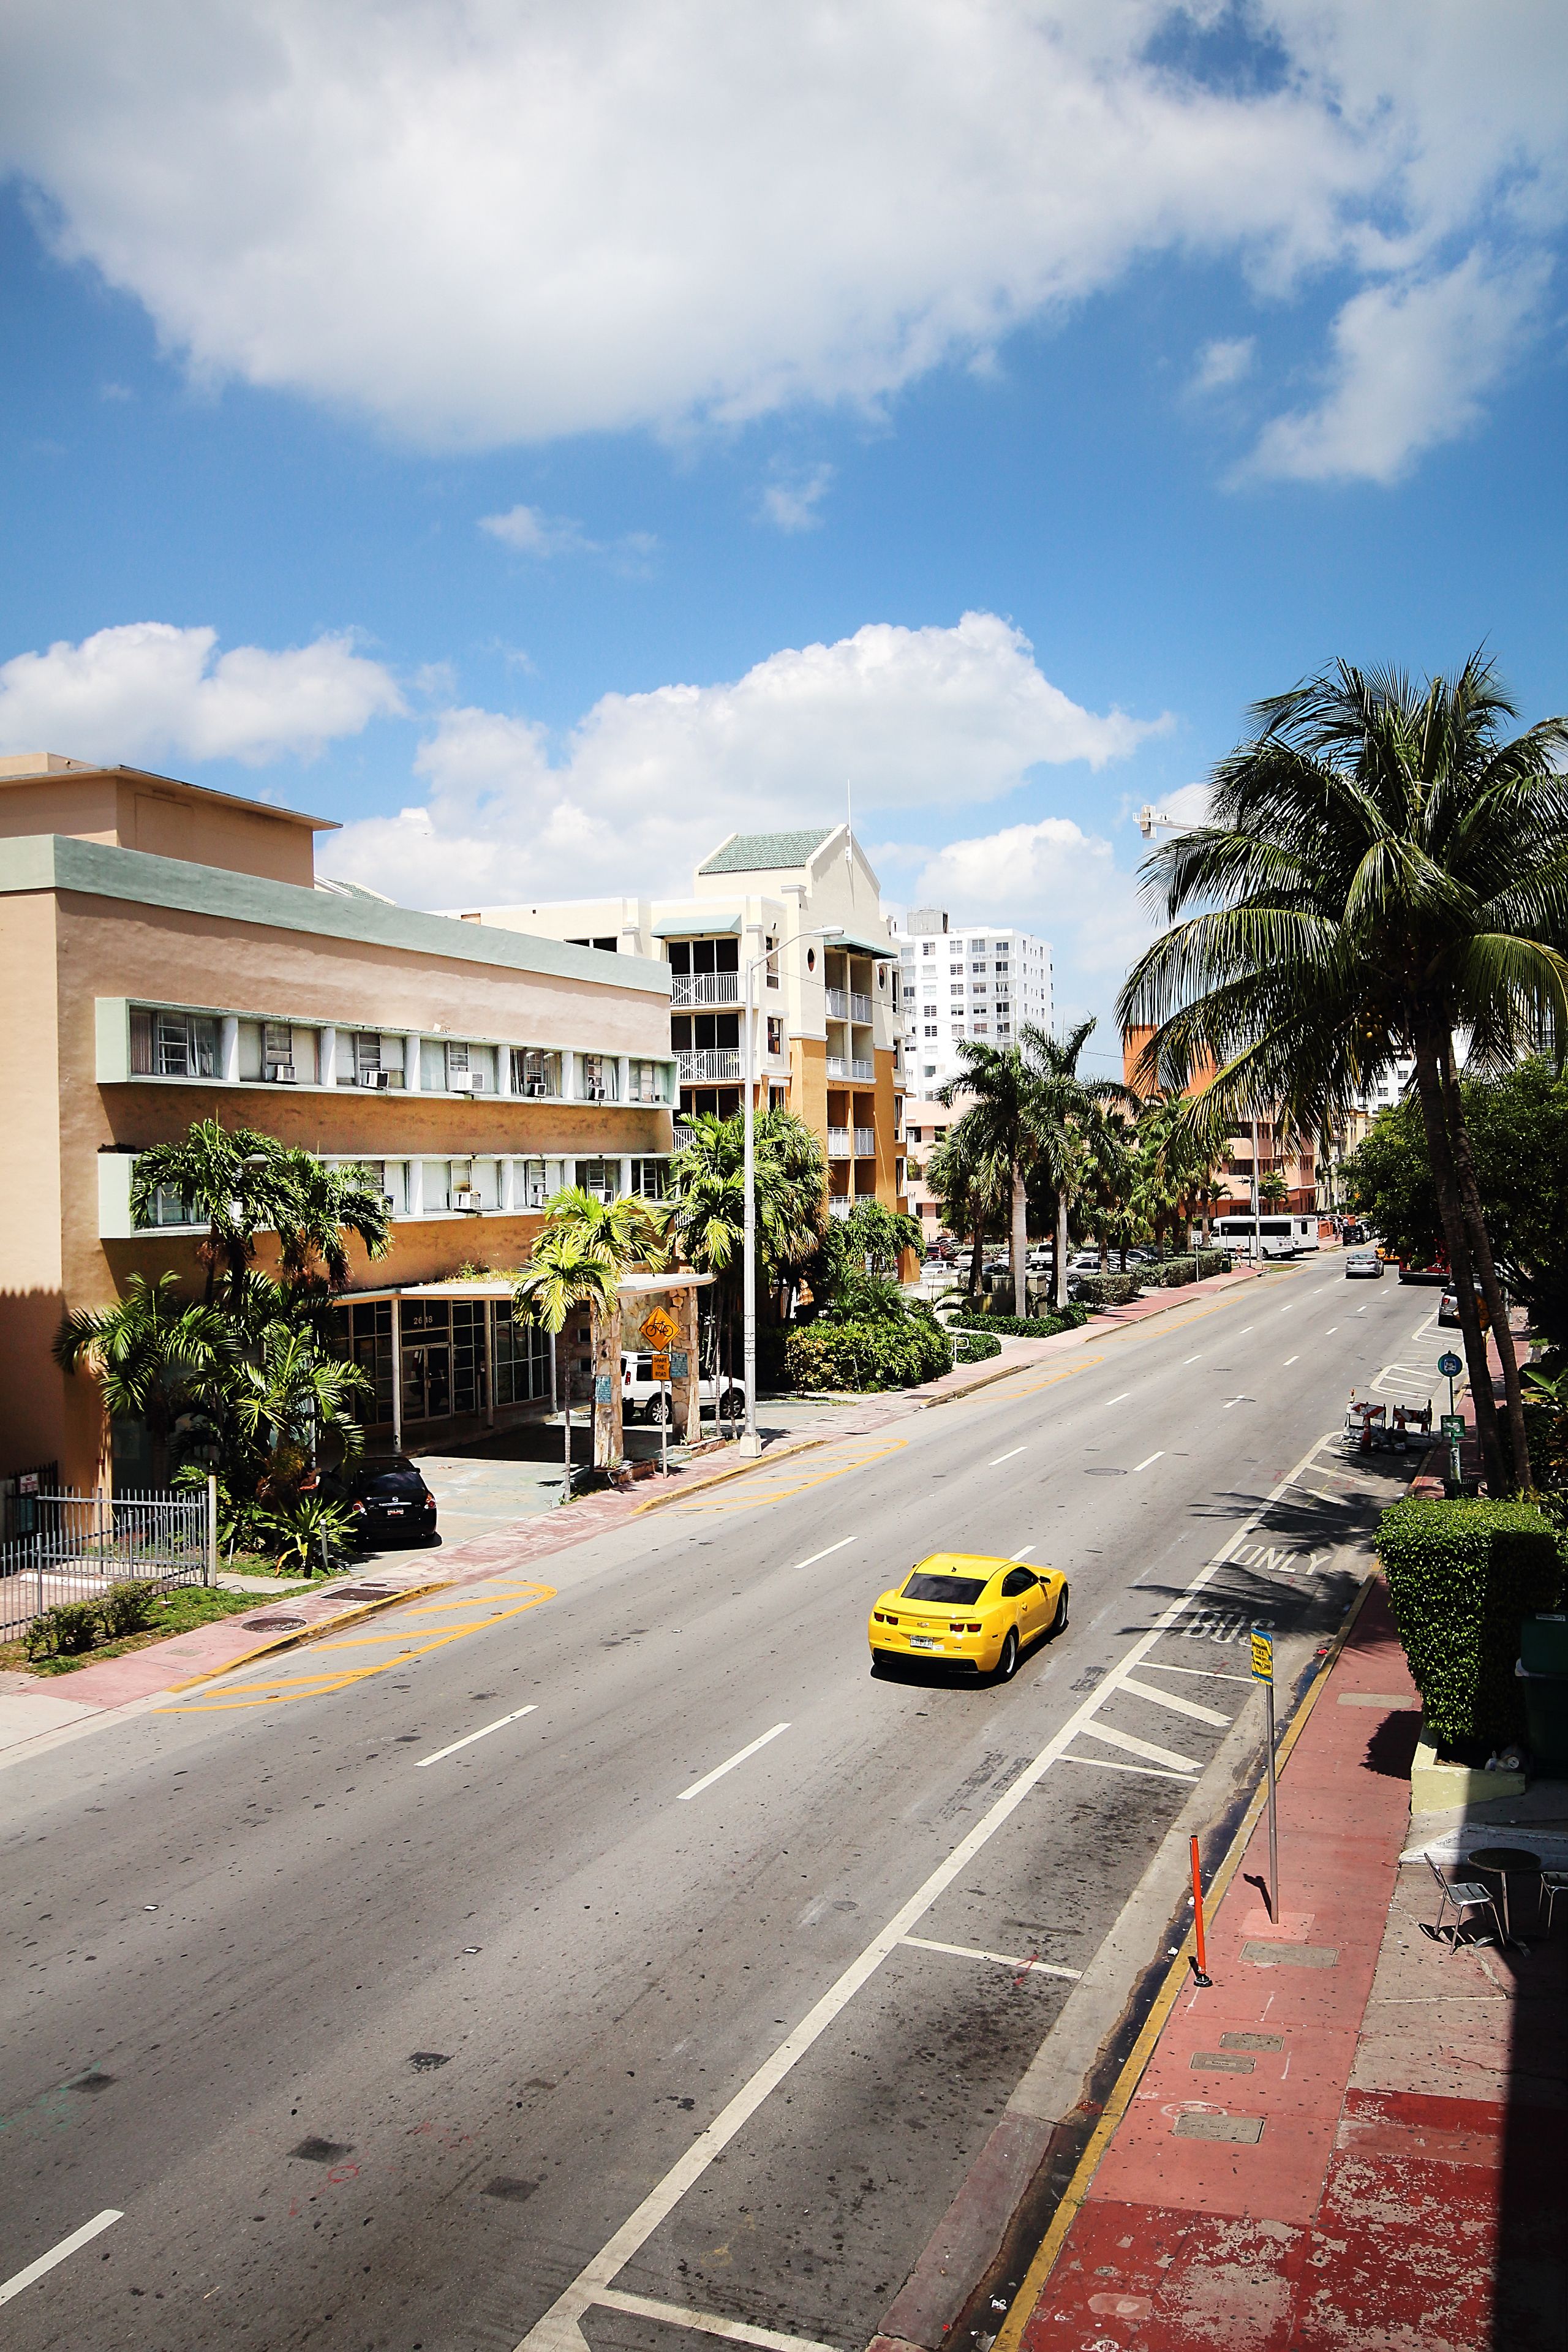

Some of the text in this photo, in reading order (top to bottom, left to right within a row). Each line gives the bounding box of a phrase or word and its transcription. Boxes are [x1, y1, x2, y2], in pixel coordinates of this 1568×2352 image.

[413, 1316, 433, 1325] 2618
[1229, 1544, 1332, 1575] ONLY
[1180, 1609, 1275, 1648] BUS
